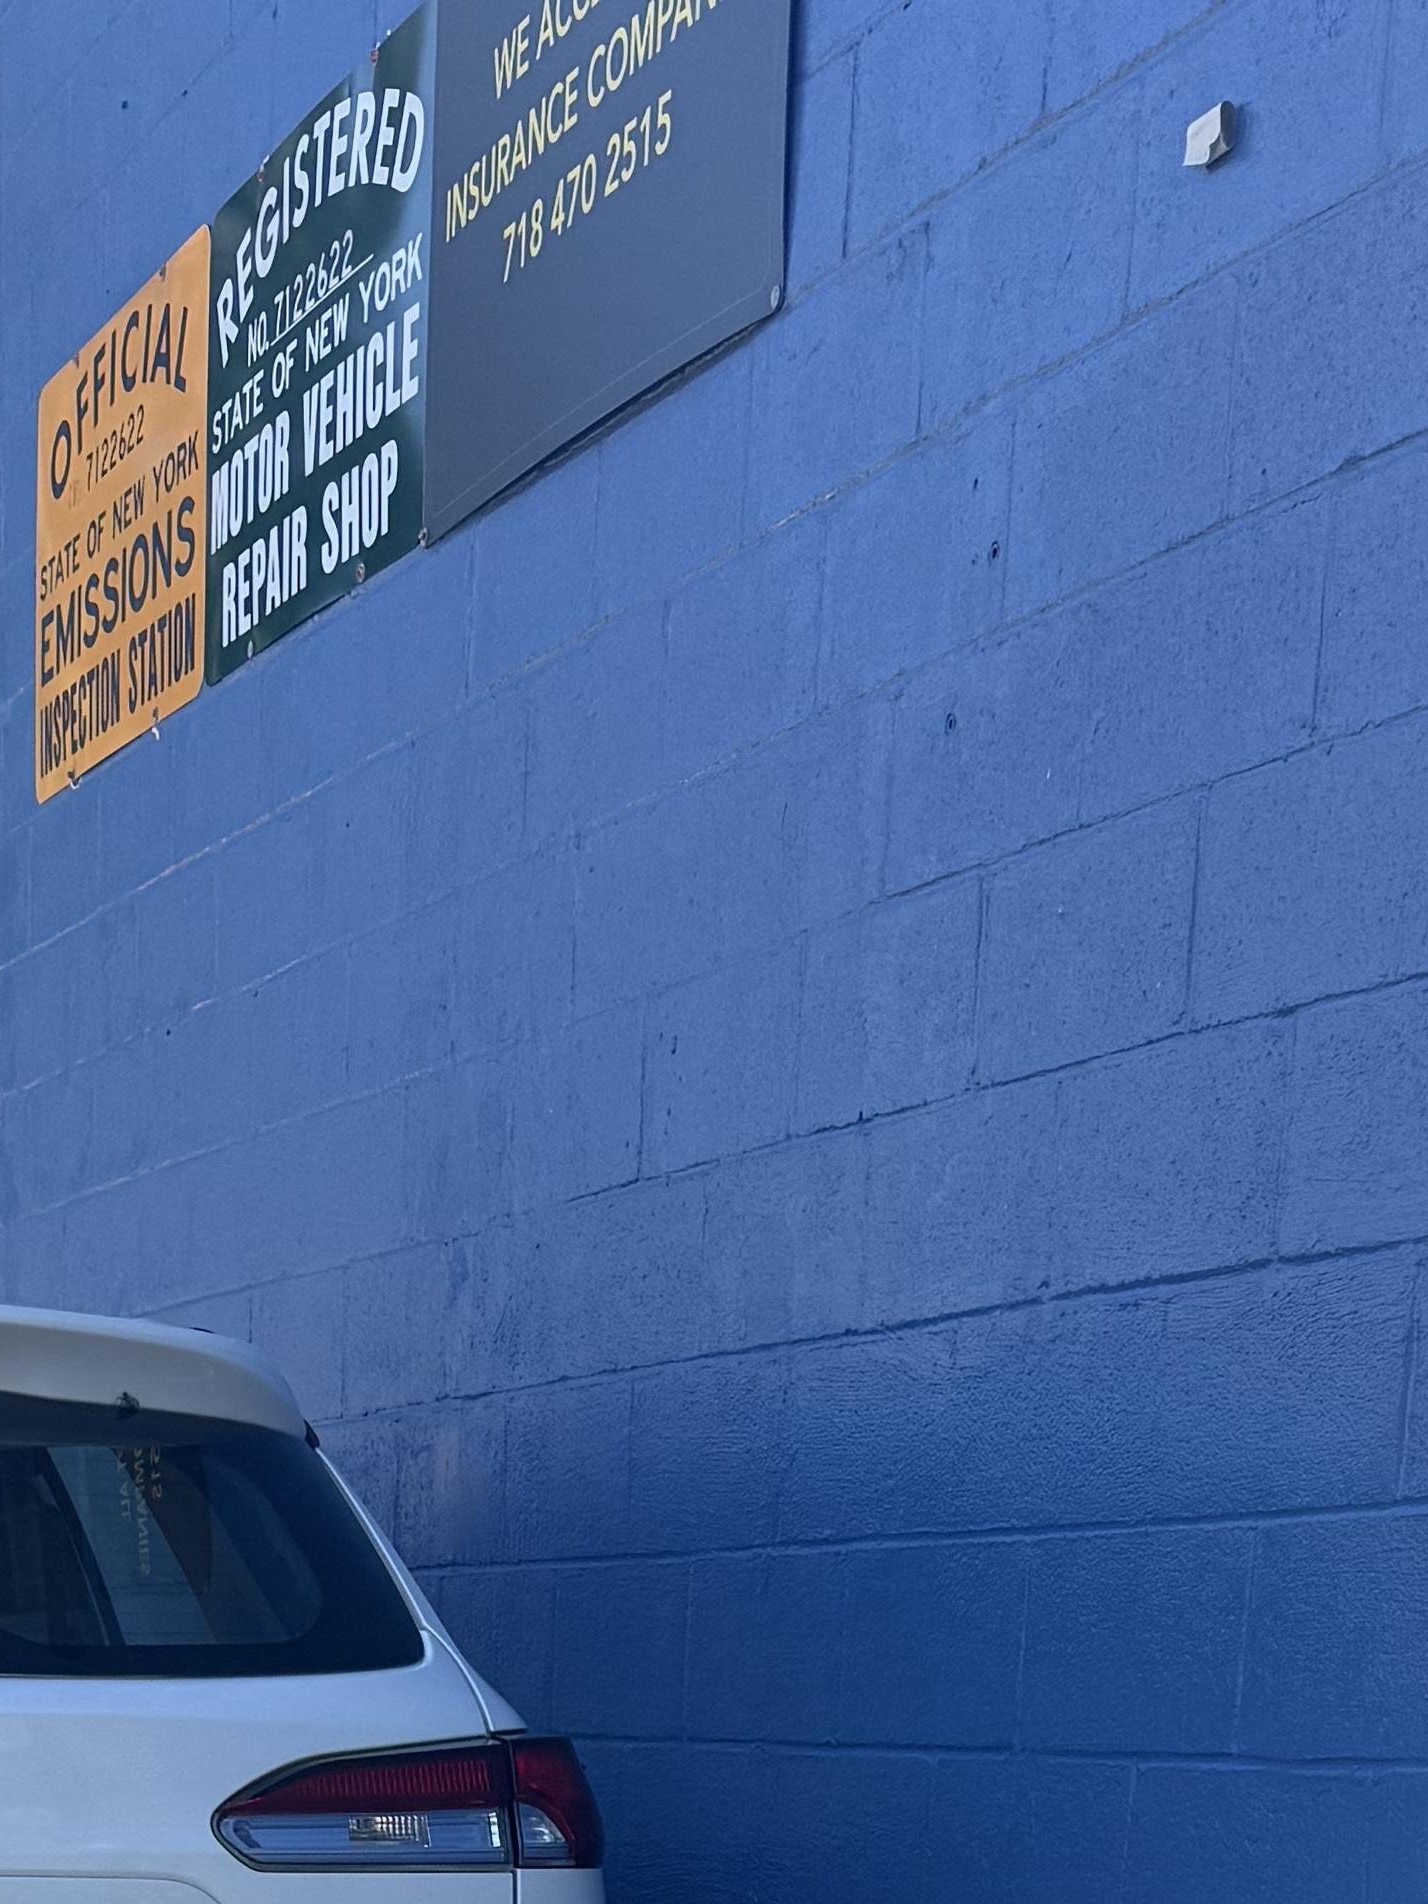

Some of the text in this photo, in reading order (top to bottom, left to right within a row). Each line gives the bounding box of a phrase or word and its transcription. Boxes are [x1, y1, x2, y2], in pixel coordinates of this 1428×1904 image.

[494, 14, 530, 99] WE
[217, 88, 424, 368] REGISTERED
[446, 66, 579, 242] INSURANCE
[503, 89, 671, 284] 718 470 2515
[212, 232, 422, 455] STATE OF NEW YORK
[274, 229, 354, 337] 7122622
[50, 303, 189, 500] OFFICIAL
[85, 404, 145, 491] 7122622
[211, 302, 420, 555] MOTOR VEHICLE
[40, 533, 80, 602] STATE
[87, 511, 106, 559] OF
[112, 475, 145, 540] NEW
[152, 431, 199, 502] YORK
[41, 496, 196, 688] EMISSIONS
[222, 439, 398, 648] REPAIR SHOP
[40, 592, 196, 778] INSPECTION STATION
